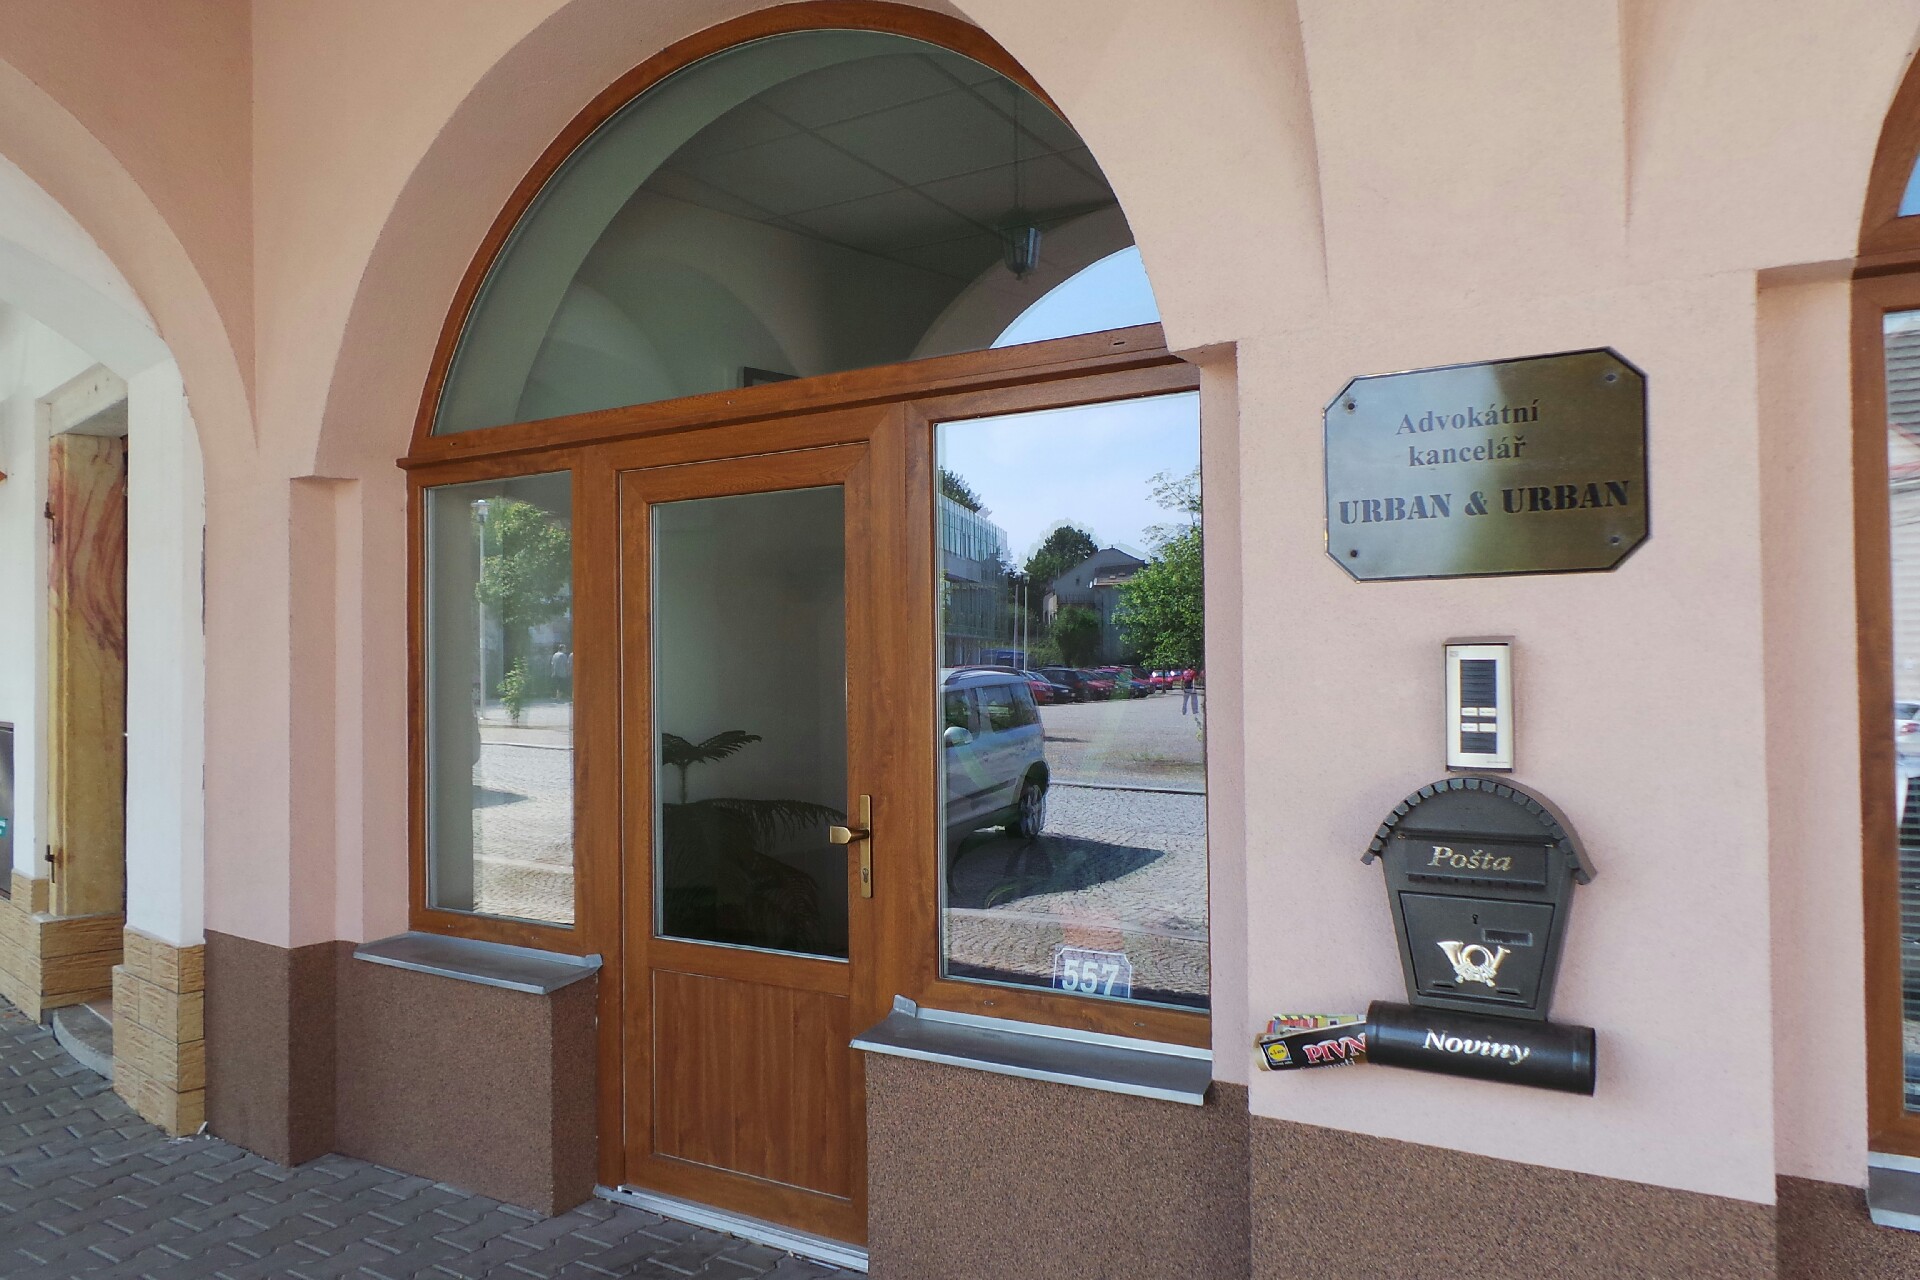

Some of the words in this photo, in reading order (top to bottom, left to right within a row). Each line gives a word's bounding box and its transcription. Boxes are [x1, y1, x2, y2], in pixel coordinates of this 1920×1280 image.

[1395, 399, 1539, 436] Advokátní
[1409, 435, 1527, 467] kancelář
[1339, 493, 1452, 525] URBAN
[1464, 490, 1488, 516] &
[1502, 480, 1630, 514] URBAN
[1427, 845, 1513, 872] Pošta
[1062, 959, 1119, 996] 557
[1422, 1028, 1531, 1066] Noviny
